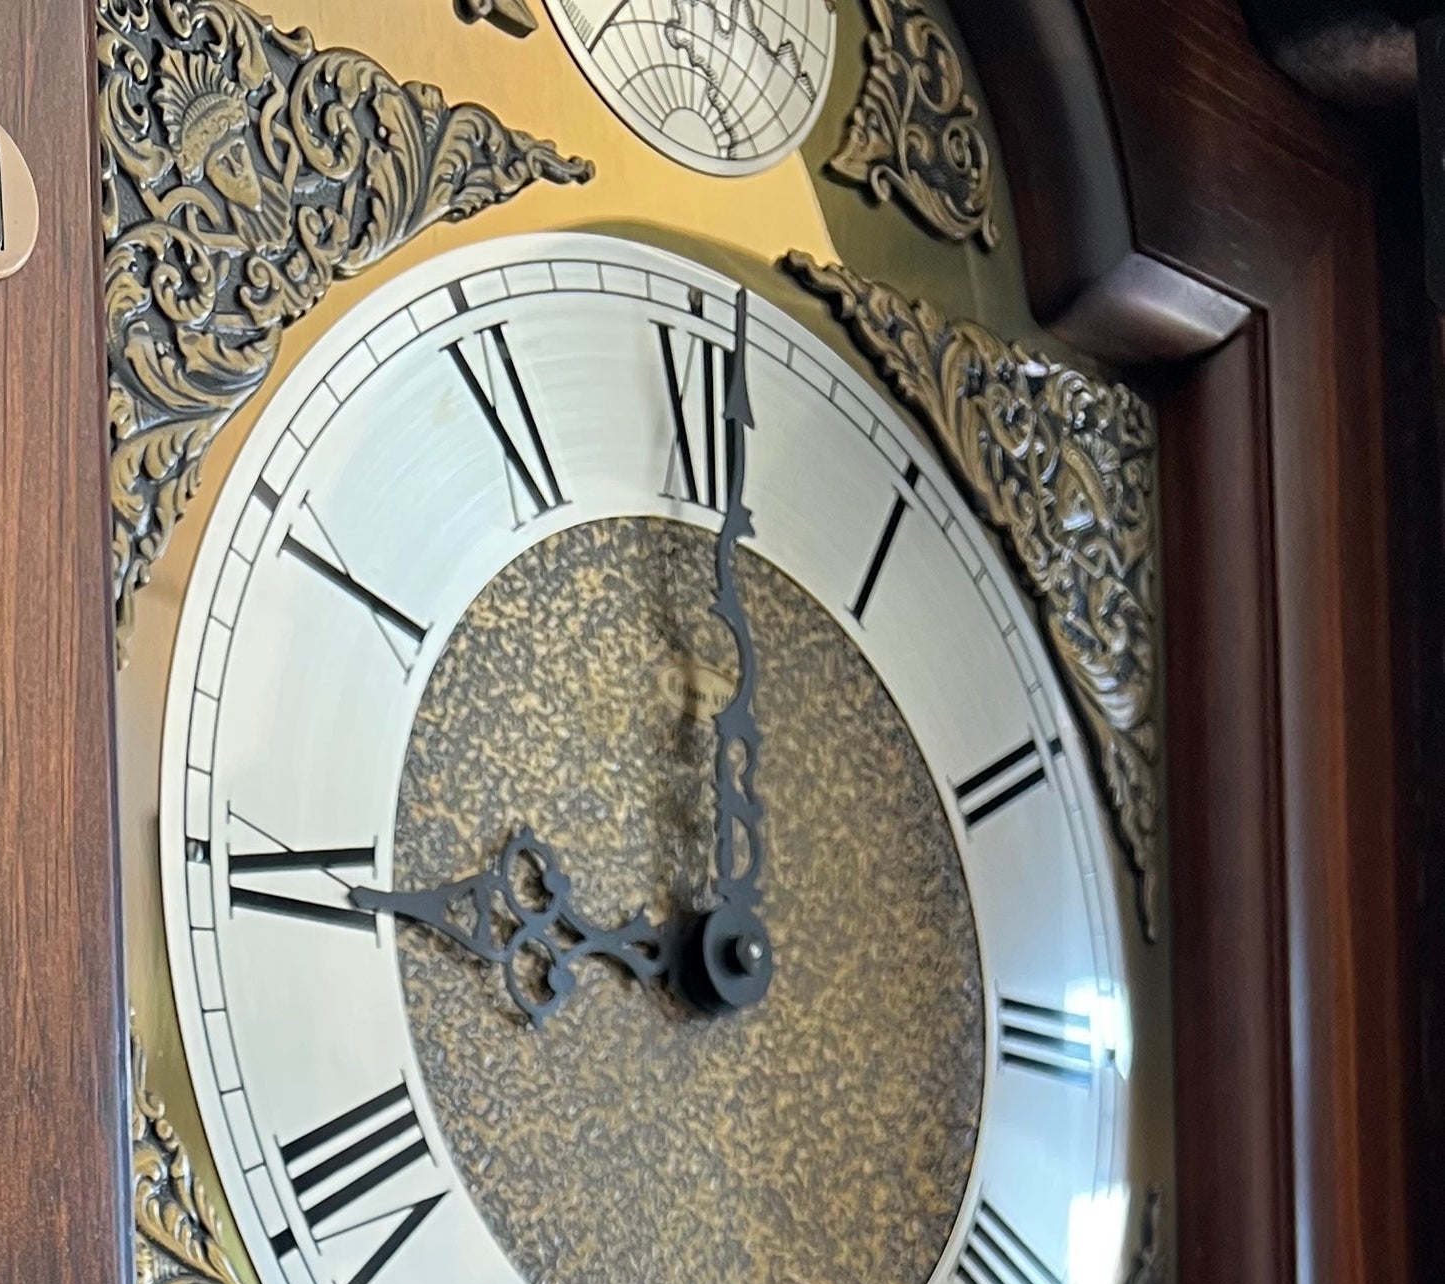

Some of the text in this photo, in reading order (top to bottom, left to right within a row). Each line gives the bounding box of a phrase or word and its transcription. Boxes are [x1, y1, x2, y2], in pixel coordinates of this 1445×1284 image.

[439, 321, 573, 531] XI
[278, 491, 436, 682] X
[846, 485, 917, 628] I
[946, 722, 1050, 844] II
[226, 800, 381, 949] IX
[995, 978, 1093, 1102] III
